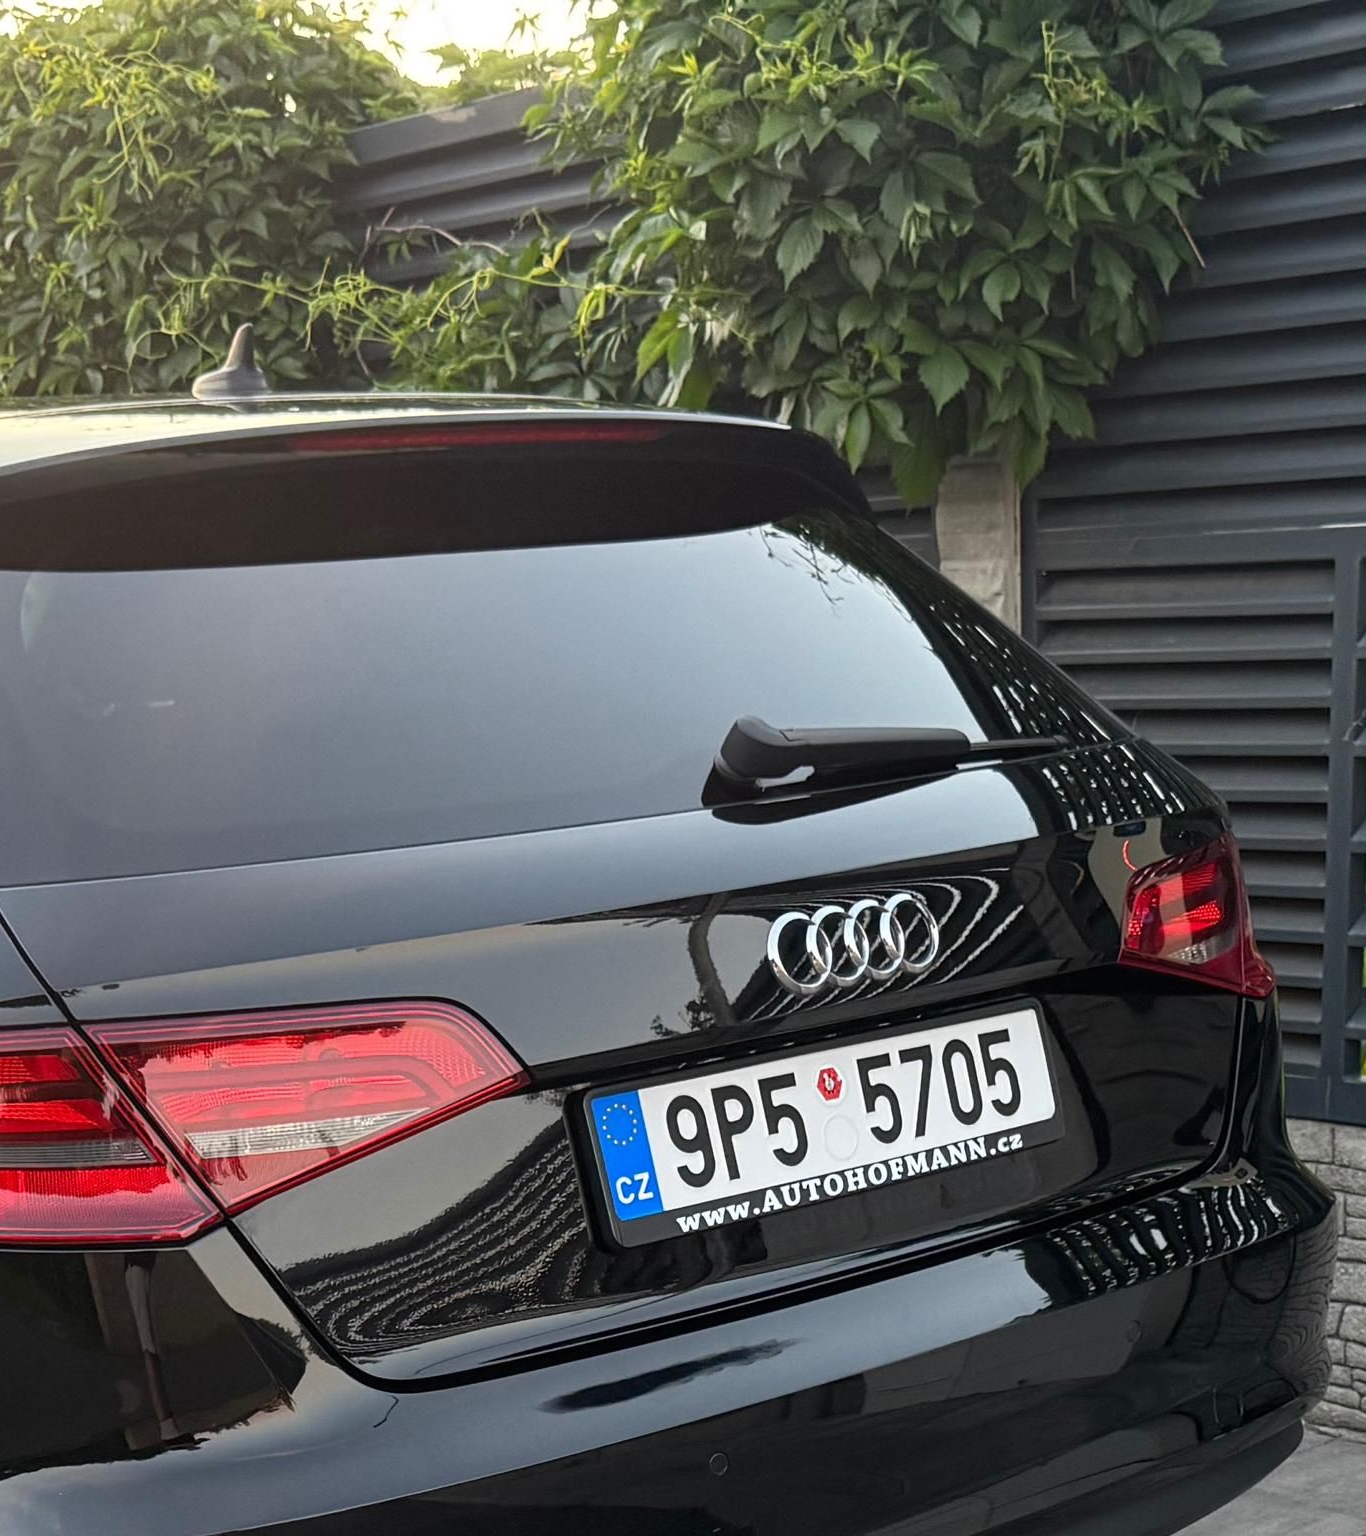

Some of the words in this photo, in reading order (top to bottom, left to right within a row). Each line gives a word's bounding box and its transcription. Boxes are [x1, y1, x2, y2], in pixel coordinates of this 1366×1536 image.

[665, 1072, 808, 1188] 9P5
[855, 1028, 1022, 1144] 5705
[615, 1171, 655, 1206] CZ
[676, 1132, 1024, 1234] www.AUTOHOFMANN.cz
